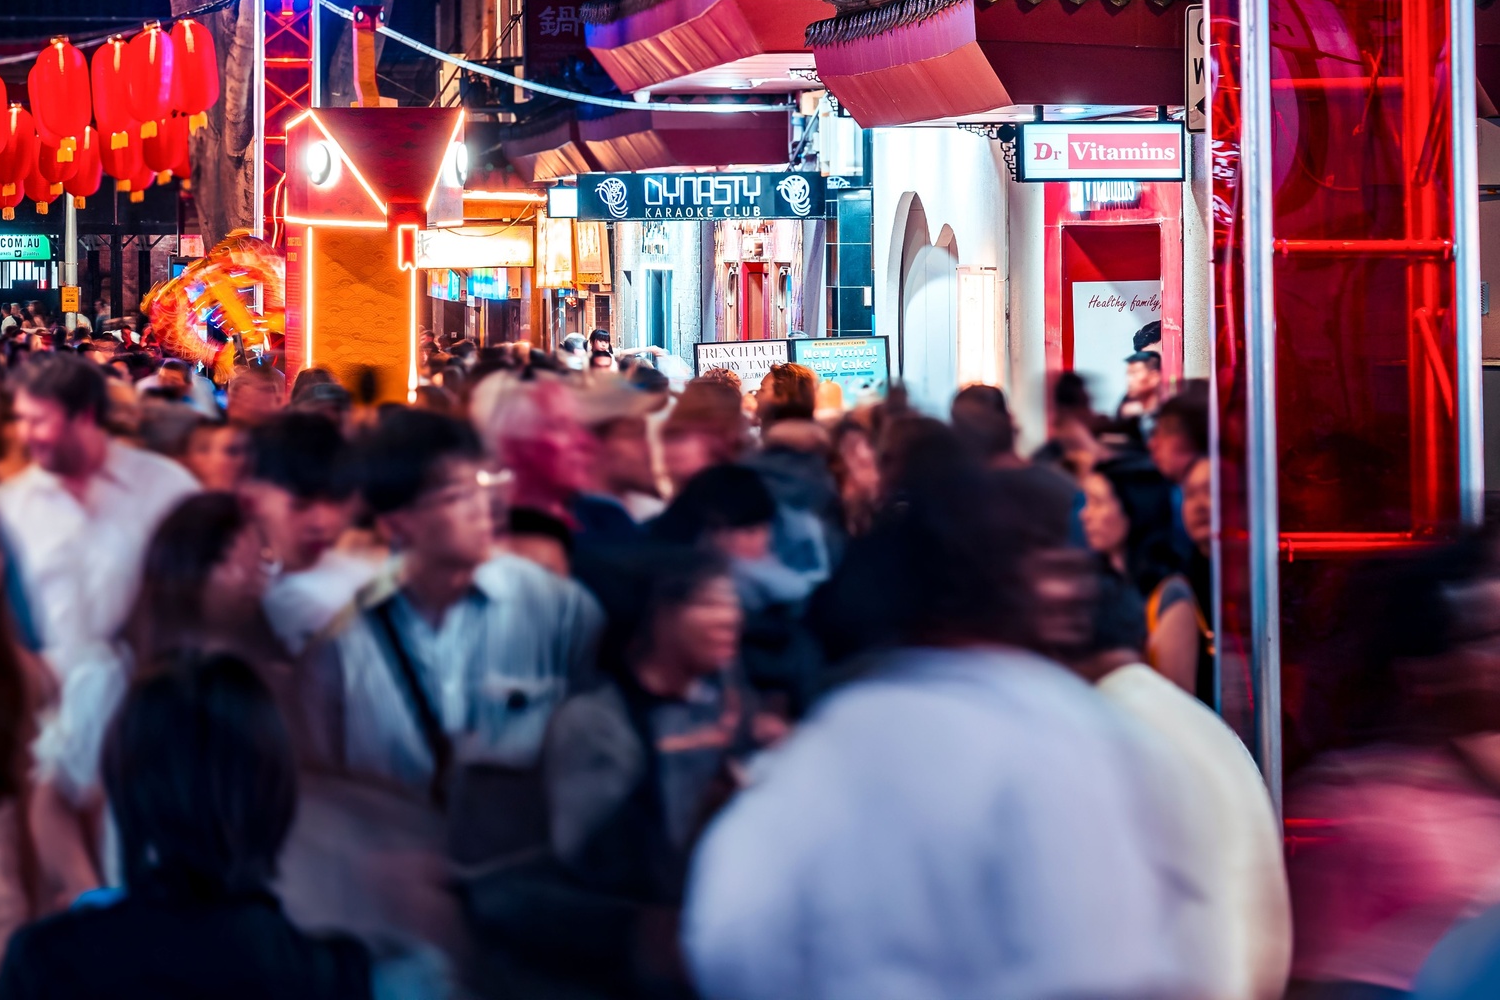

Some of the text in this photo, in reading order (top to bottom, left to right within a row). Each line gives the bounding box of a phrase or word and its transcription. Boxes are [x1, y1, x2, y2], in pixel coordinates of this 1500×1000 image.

[1033, 141, 1176, 161] Dr Vitamins
[644, 175, 761, 206] DYNASTY
[644, 206, 761, 218] KARAOKE CLUB
[1088, 294, 1162, 312] Healthy family,
[698, 344, 786, 359] FRENCH PUFF
[803, 346, 878, 360] New Arrival
